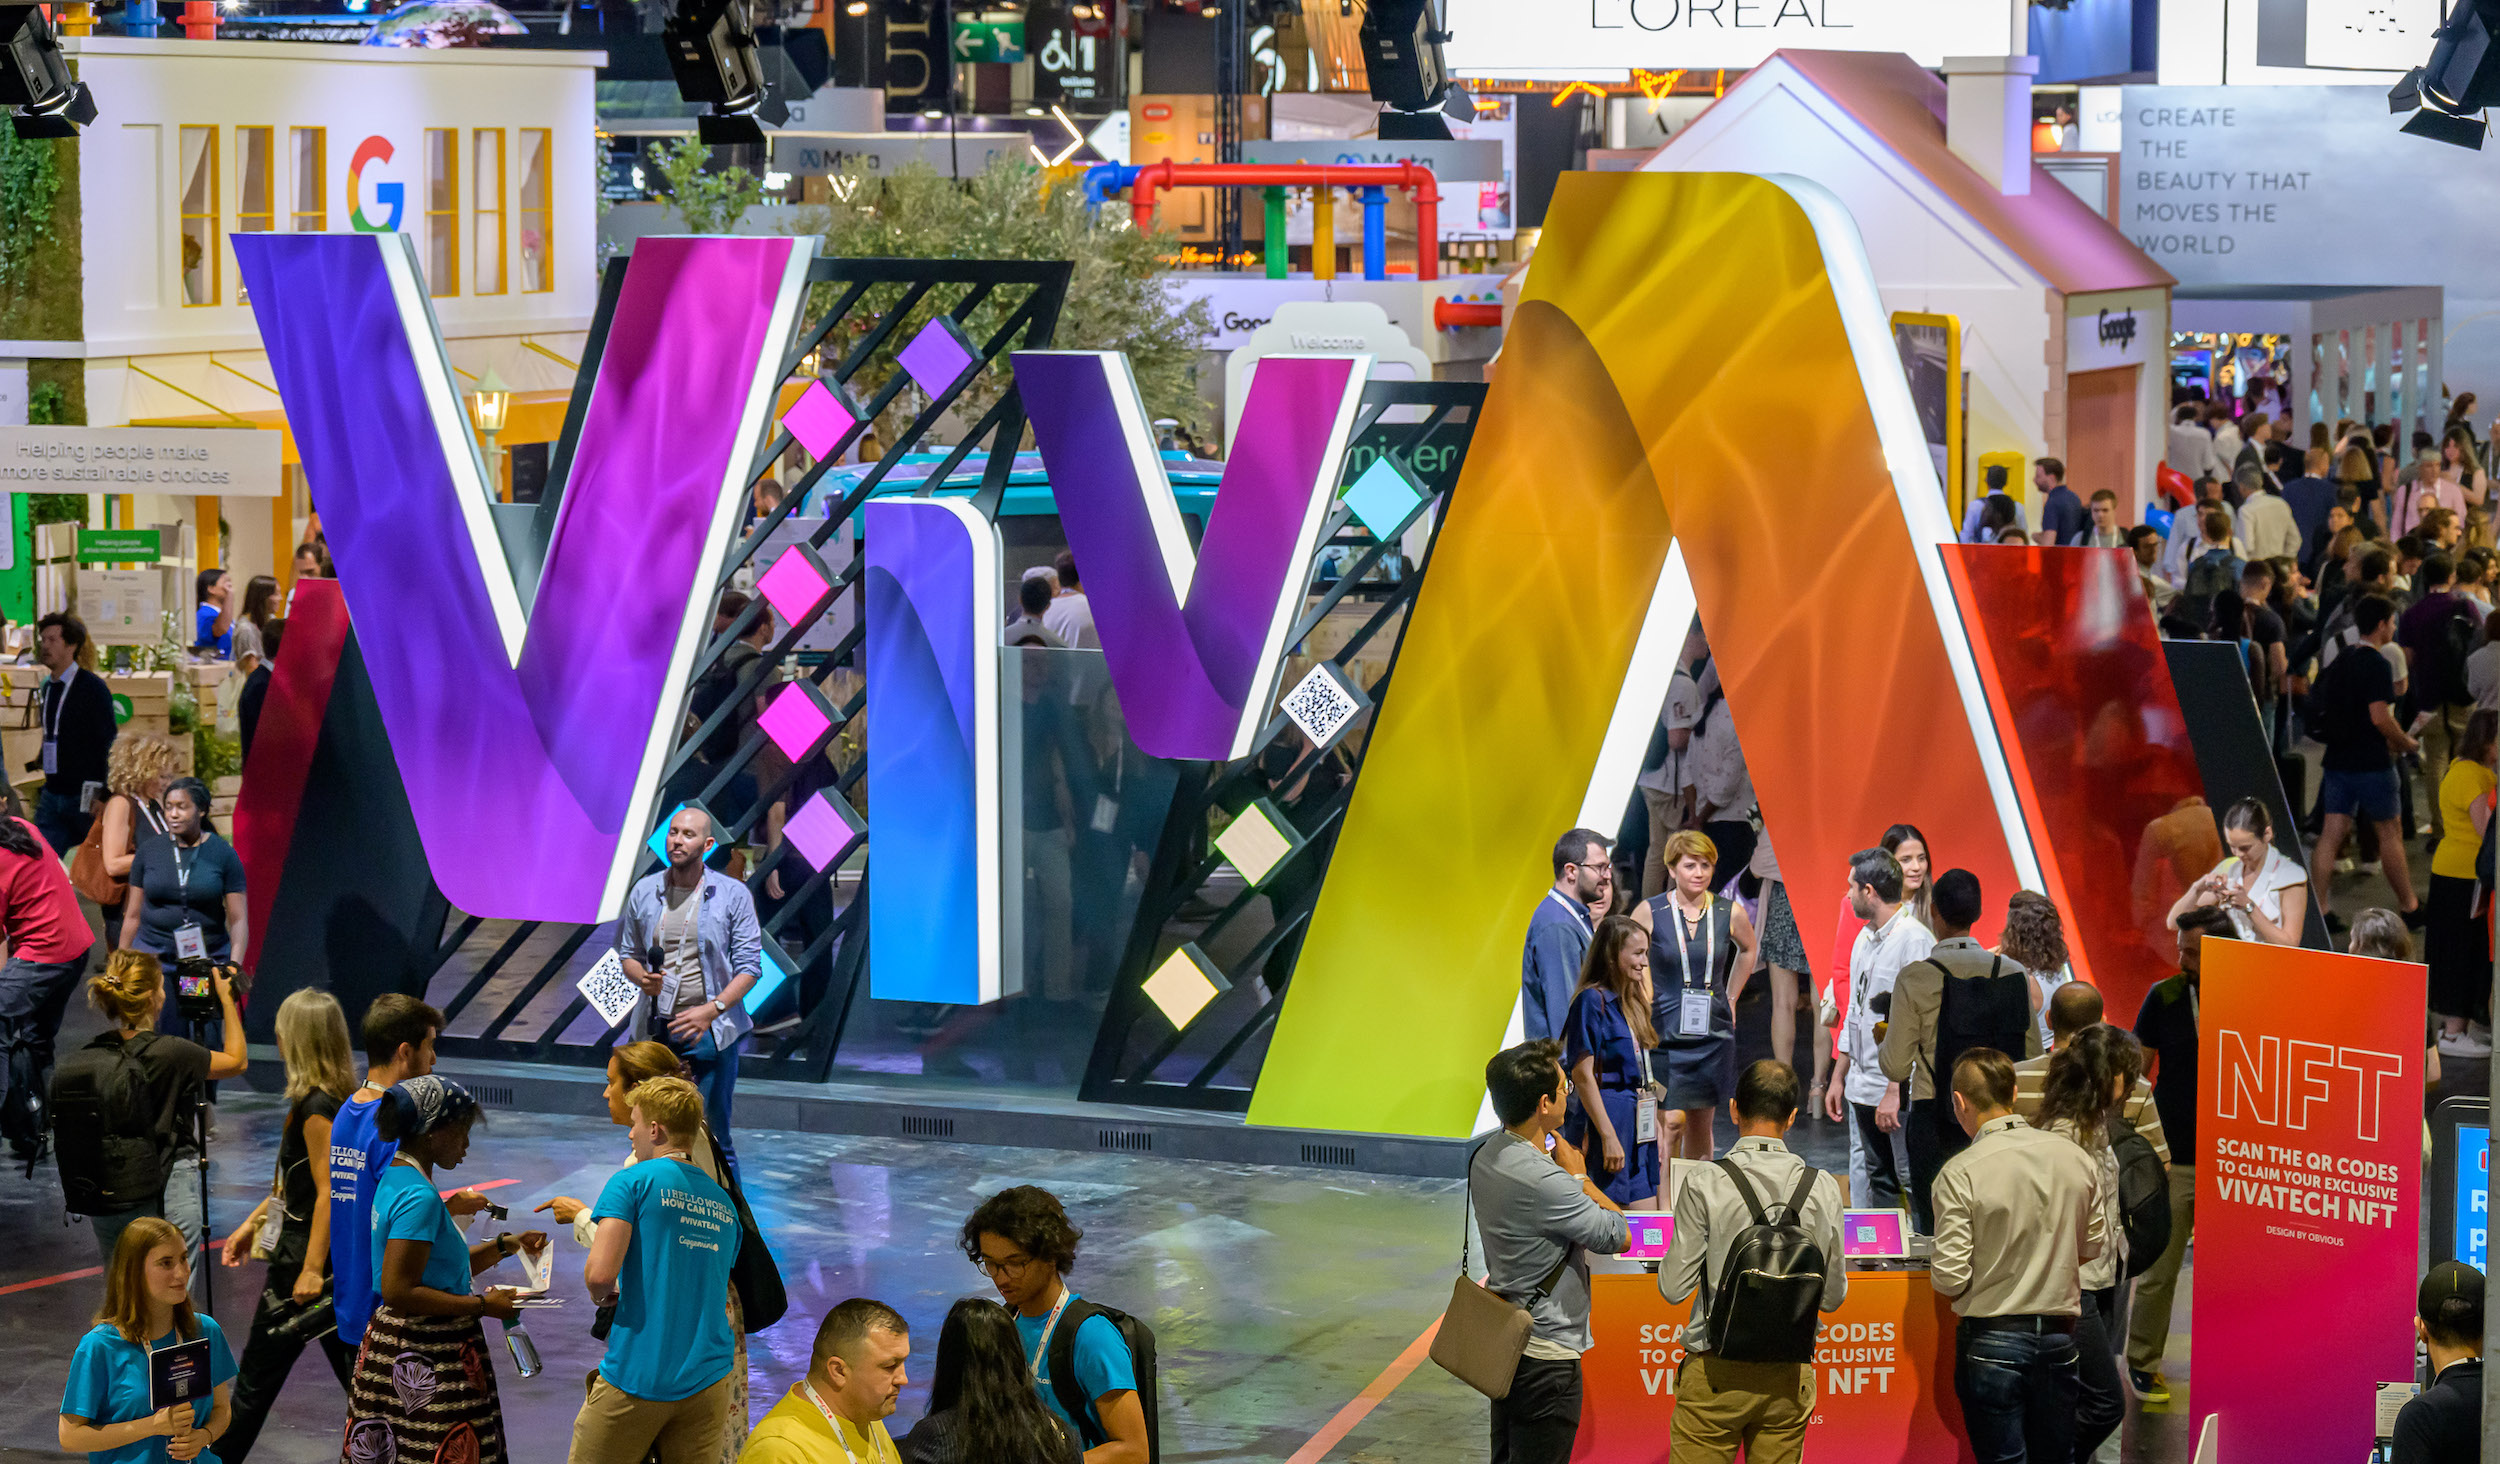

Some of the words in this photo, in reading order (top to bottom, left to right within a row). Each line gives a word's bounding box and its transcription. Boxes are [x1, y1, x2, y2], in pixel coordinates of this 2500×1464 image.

[1592, 0, 1853, 31] LOREAL
[2138, 107, 2236, 127] CREATE
[1370, 152, 1435, 168] Mta
[2139, 140, 2188, 159] THE
[347, 135, 405, 232] G
[2137, 172, 2237, 191] BEAUTY
[2246, 172, 2312, 191] THAT
[2136, 203, 2220, 223] MOVES
[2229, 203, 2278, 223] THE
[2136, 234, 2236, 255] WORLD
[2099, 306, 2136, 349] Google
[1290, 331, 1367, 350] Welcome
[17, 440, 87, 462] Helping
[91, 442, 155, 462] people
[159, 444, 209, 461] make
[0, 466, 48, 480] more
[53, 464, 156, 482] sustainable
[160, 465, 231, 484] choices
[2217, 1029, 2402, 1142] NFT
[2217, 1137, 2264, 1161] SCAN
[2267, 1145, 2302, 1167] THE
[2306, 1152, 2333, 1173] QR
[2337, 1157, 2399, 1183] CODES
[2216, 1159, 2236, 1174] TO
[2238, 1162, 2280, 1182] CLAIM
[2283, 1170, 2321, 1189] YOUR
[2324, 1177, 2398, 1202] EXCLUSIVE
[661, 1198, 685, 1210] HOW
[687, 1203, 705, 1215] CAN
[712, 1210, 734, 1226] HELP?
[2216, 1175, 2340, 1220] VIVATECH
[2348, 1198, 2397, 1229] NFT
[2266, 1225, 2295, 1239] DESIGN
[2297, 1231, 2307, 1241] BY
[2308, 1232, 2344, 1247] OBVIOUS
[1640, 1323, 1685, 1344] SCA
[1815, 1322, 1895, 1343] CODES
[1639, 1349, 1666, 1364] TO
[1811, 1347, 1895, 1364] XCLUSIVE
[1828, 1367, 1895, 1395] NFT
